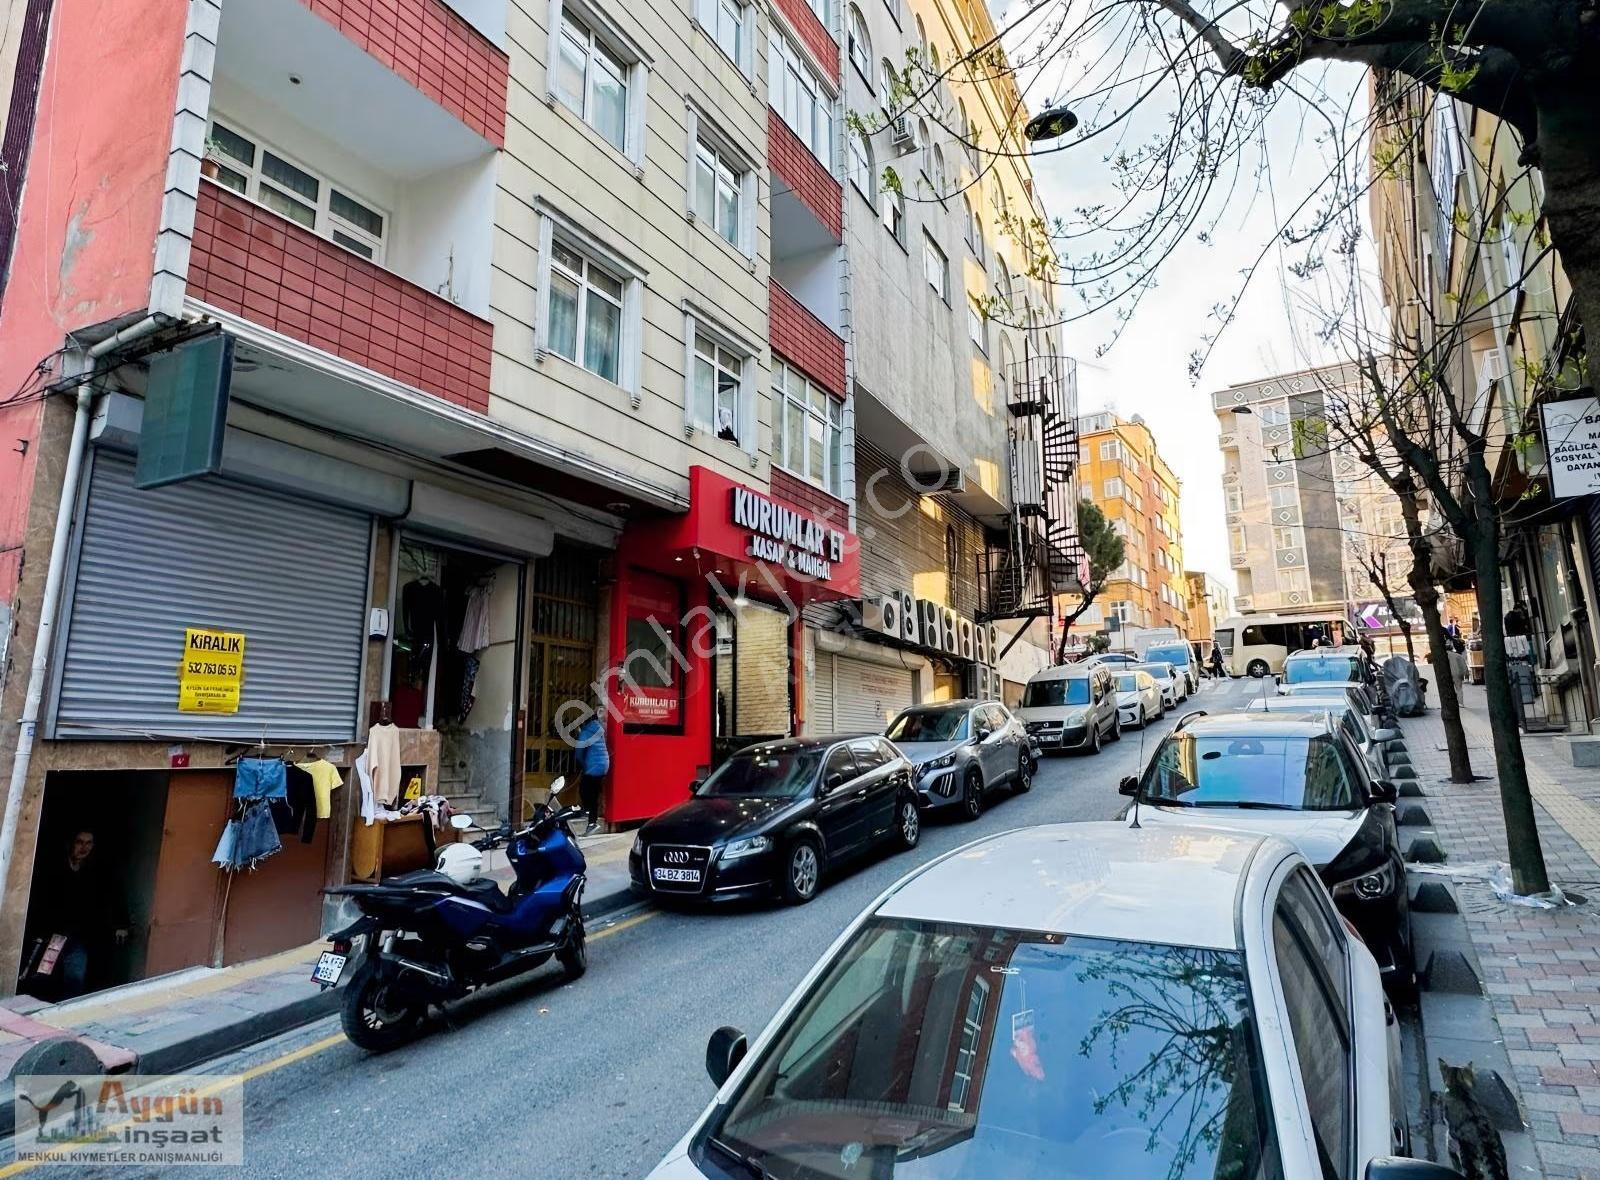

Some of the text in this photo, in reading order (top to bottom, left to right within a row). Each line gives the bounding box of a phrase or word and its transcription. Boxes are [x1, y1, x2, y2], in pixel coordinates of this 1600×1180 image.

[1554, 442, 1598, 454] BAĞLICA
[1554, 452, 1594, 463] SOSYAL
[734, 486, 845, 563] KURUMLAR ET
[753, 534, 832, 580] KASAP & MANGAL
[188, 662, 237, 676] 532 763 05 53
[656, 869, 699, 881] 34 BZ 3814
